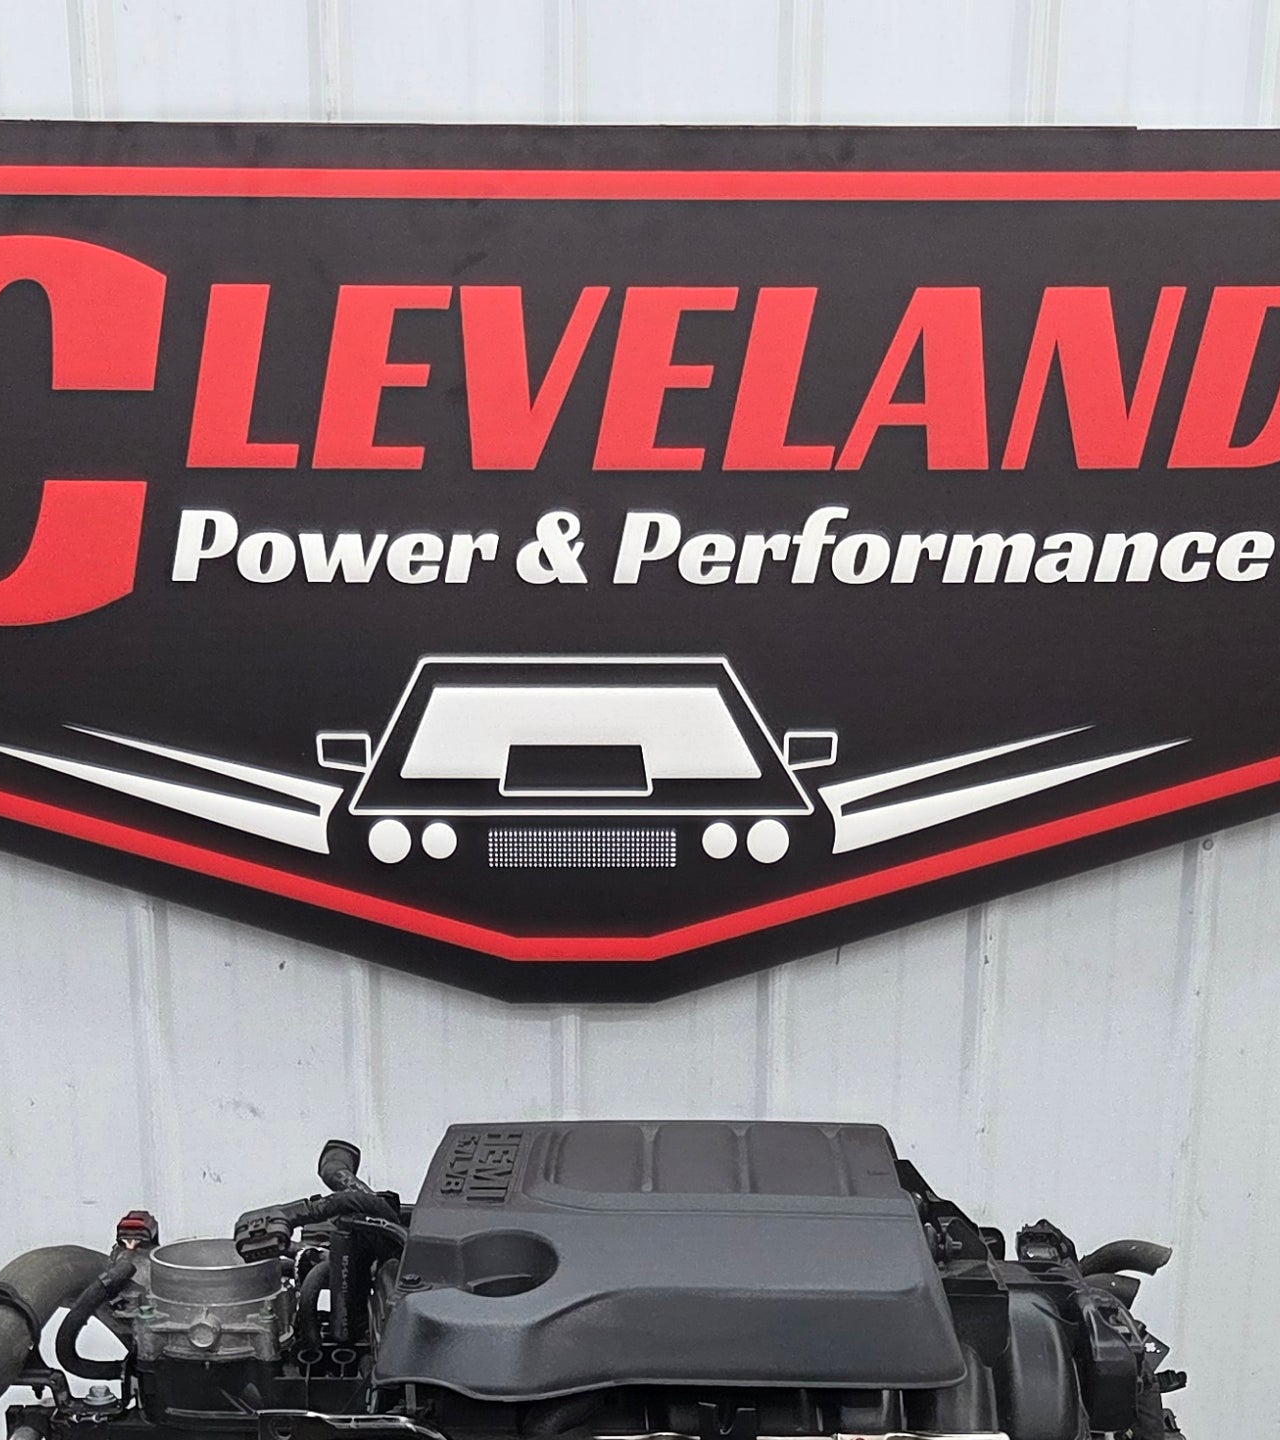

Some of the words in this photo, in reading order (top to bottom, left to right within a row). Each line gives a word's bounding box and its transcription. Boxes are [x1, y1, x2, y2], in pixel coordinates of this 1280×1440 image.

[171, 508, 500, 584] Power
[516, 510, 588, 585] &
[612, 505, 1276, 585] Performance
[465, 1131, 523, 1204] HEMI
